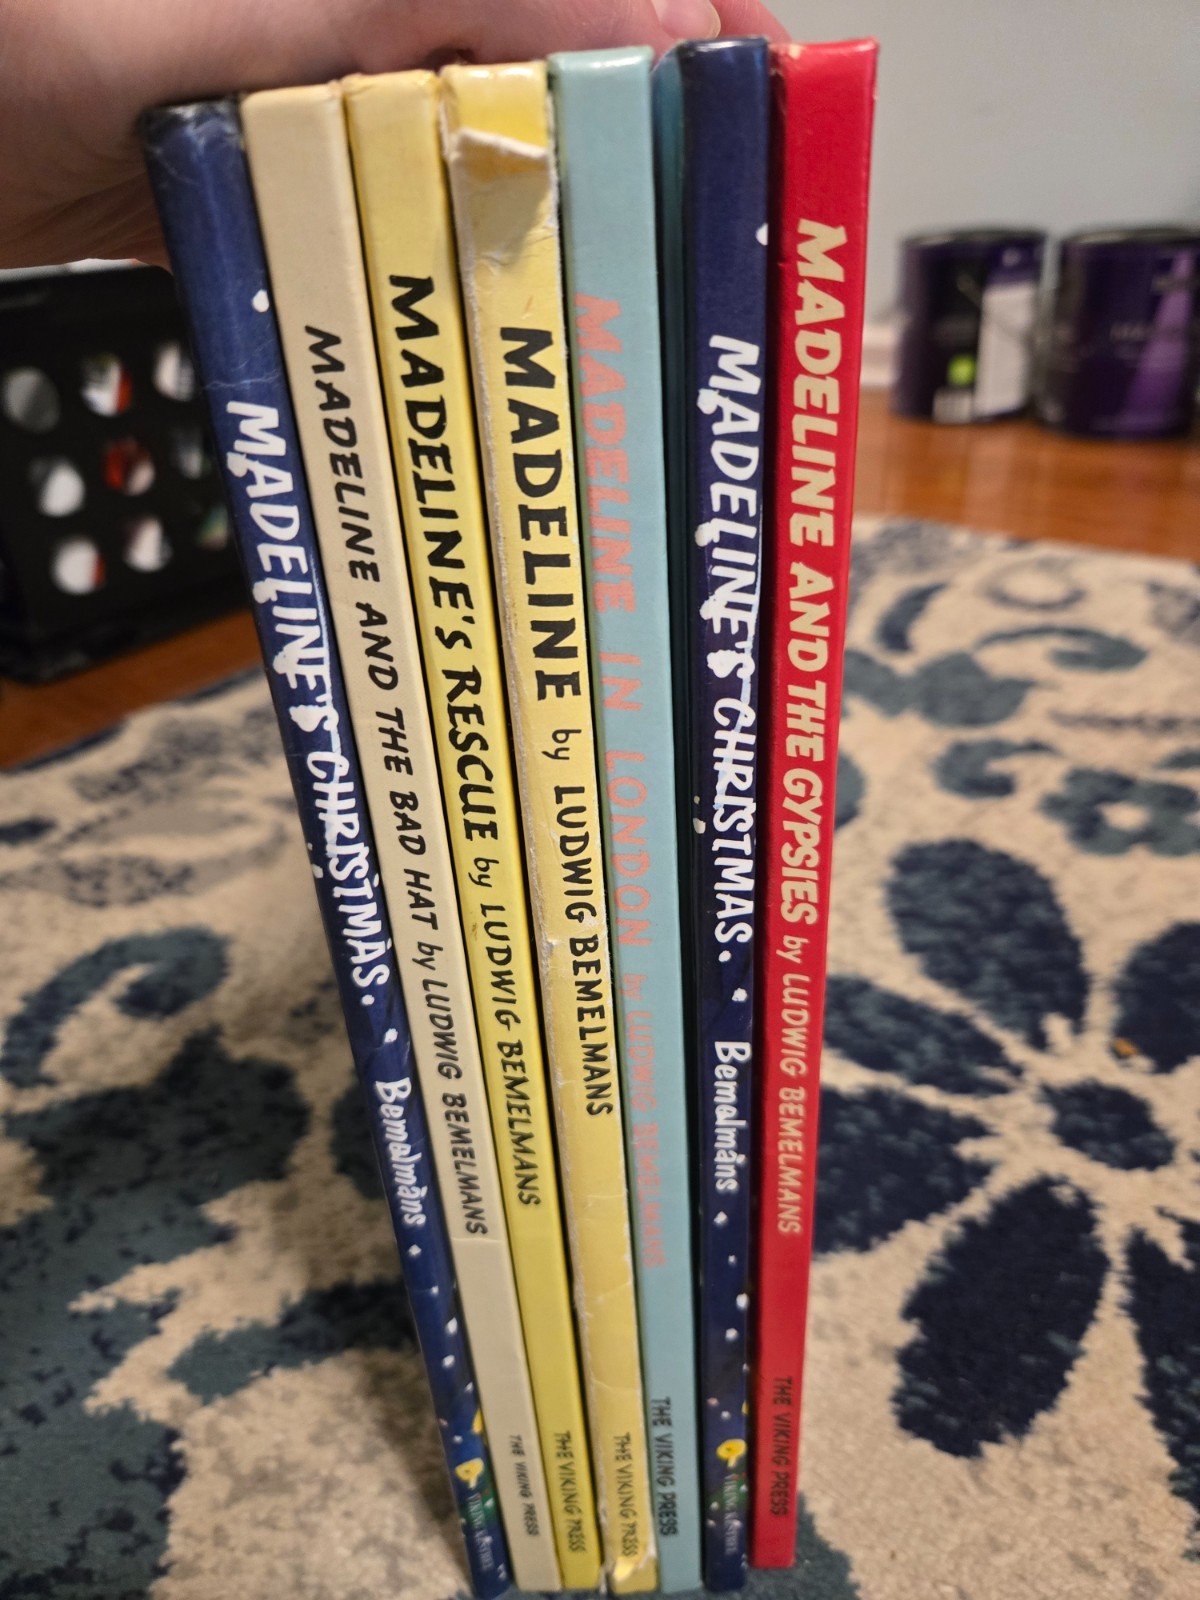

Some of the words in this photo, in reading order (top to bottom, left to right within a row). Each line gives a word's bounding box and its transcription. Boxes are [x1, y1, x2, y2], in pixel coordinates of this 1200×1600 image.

[790, 218, 847, 546] MADELINE
[304, 325, 380, 582] MADELINE
[389, 275, 475, 650] MADELINE'S
[575, 295, 636, 613] MADELINE
[500, 326, 582, 701] MADELINE
[702, 335, 761, 678] MADELINE'S
[355, 601, 399, 691] AND
[787, 562, 834, 672] AND
[599, 651, 643, 711] IN
[375, 707, 414, 776] THE
[441, 665, 498, 842] RESCUE
[541, 729, 583, 760] by
[785, 680, 827, 762] THE
[226, 400, 340, 732] MADELINE'S
[375, 1077, 426, 1225] Bemelmans
[389, 790, 426, 856] BAD
[604, 750, 651, 946] LONDON
[780, 768, 823, 925] GYPSIES
[468, 857, 500, 888] by
[554, 785, 597, 924] LUDWIG
[403, 867, 439, 930] HAT
[412, 941, 444, 971] by
[480, 903, 521, 1031] LUDWIG
[776, 934, 809, 963] by
[619, 973, 648, 1000] by
[422, 978, 463, 1080] LUDWIG
[569, 934, 613, 1116] BEMELMANS
[624, 1012, 656, 1110] LUDWIG
[780, 973, 811, 1078] LUDWIG
[497, 1039, 542, 1206] BEMELMANS
[714, 1041, 752, 1193] Bemelmans
[442, 1092, 488, 1236] BEMELMANS
[632, 1122, 666, 1270] BEMELMANS
[778, 1086, 806, 1234] BEMELMANS
[651, 1396, 673, 1427] THE
[773, 1375, 793, 1406] THE
[509, 1434, 526, 1457] THE
[553, 1430, 574, 1459] THE
[613, 1431, 632, 1462] THE
[654, 1432, 676, 1487] VIKING
[772, 1412, 792, 1467] VIKING
[515, 1461, 534, 1498] VIKING
[558, 1462, 582, 1516] VIKING
[617, 1465, 638, 1519] VIKING
[658, 1492, 679, 1538] PRESS
[770, 1470, 790, 1518] PRESS
[522, 1502, 540, 1537] PRESS
[565, 1517, 587, 1555] PRESS
[620, 1520, 641, 1559] PRESS
